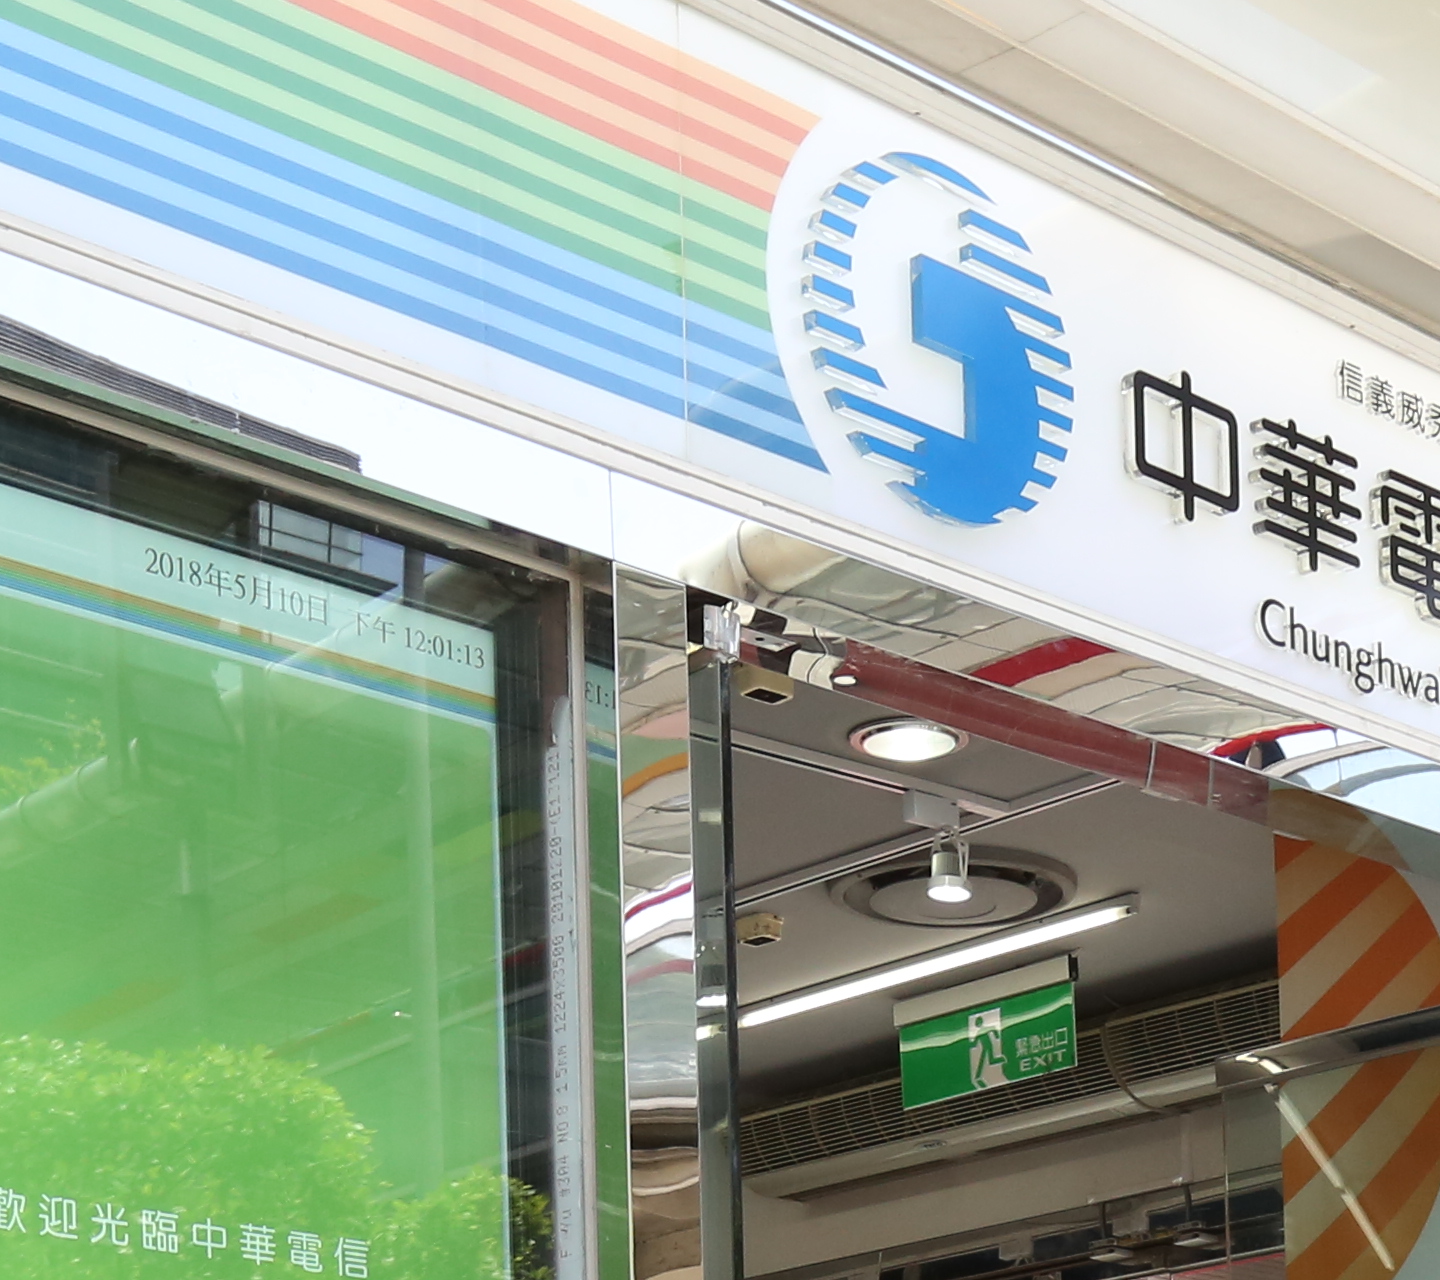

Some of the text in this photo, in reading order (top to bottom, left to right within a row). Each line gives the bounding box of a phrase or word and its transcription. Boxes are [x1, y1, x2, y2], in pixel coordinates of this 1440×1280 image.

[144, 546, 486, 670] 2018年5月10日 下午 12:01:13
[1014, 1026, 1068, 1058] 緊急出口
[1020, 1048, 1067, 1071] EXIT
